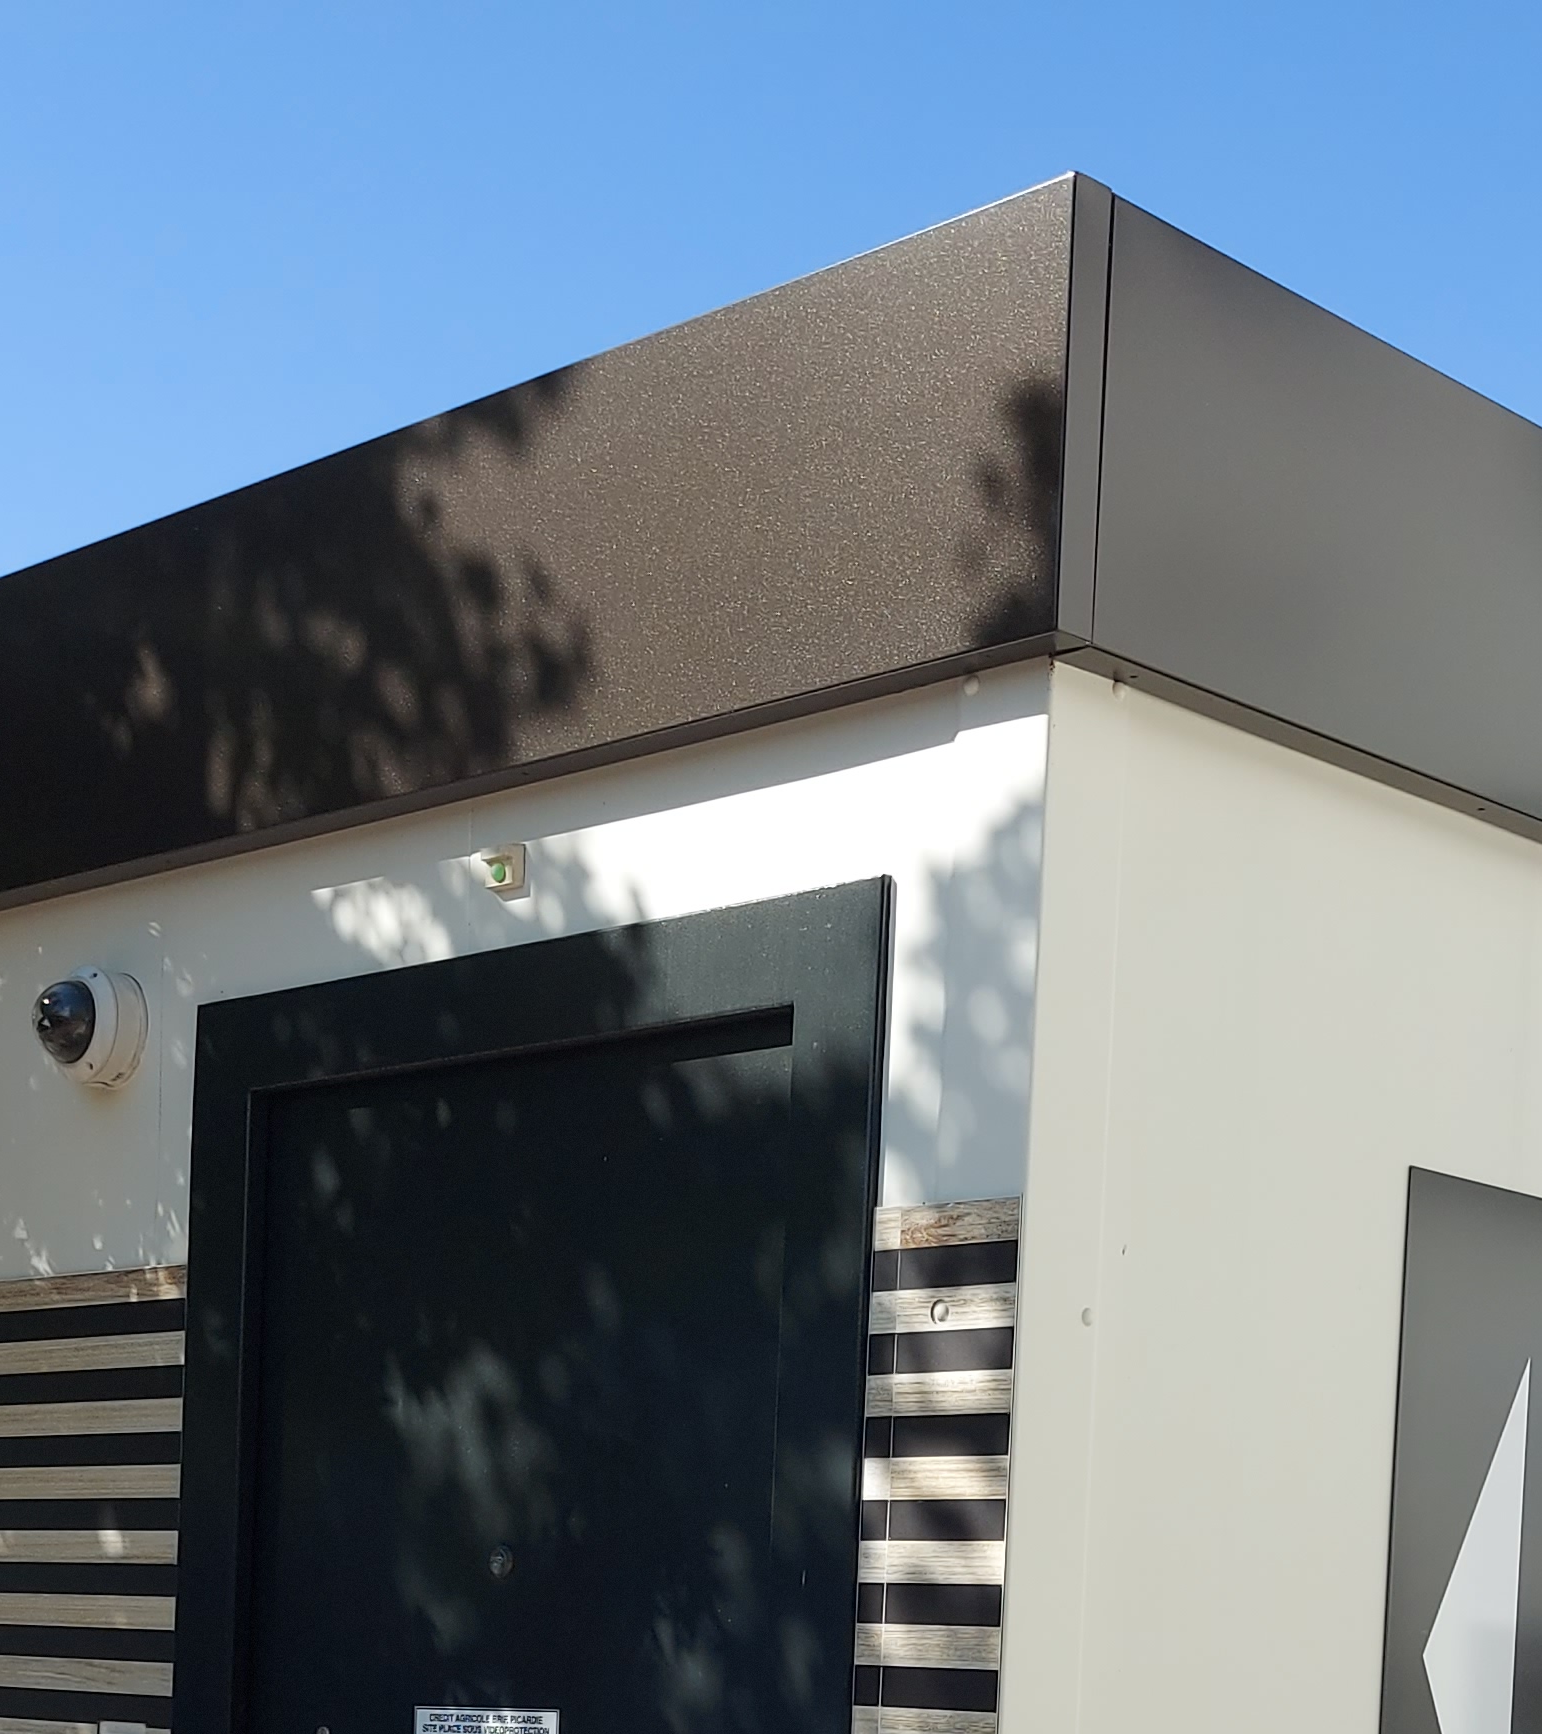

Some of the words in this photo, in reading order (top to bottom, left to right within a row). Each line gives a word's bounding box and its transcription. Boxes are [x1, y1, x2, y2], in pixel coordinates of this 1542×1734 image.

[455, 1714, 490, 1723] AGRICOLE
[510, 1716, 543, 1725] PICARDIE
[422, 1724, 437, 1733] SITE
[462, 1725, 482, 1734] SOUS
